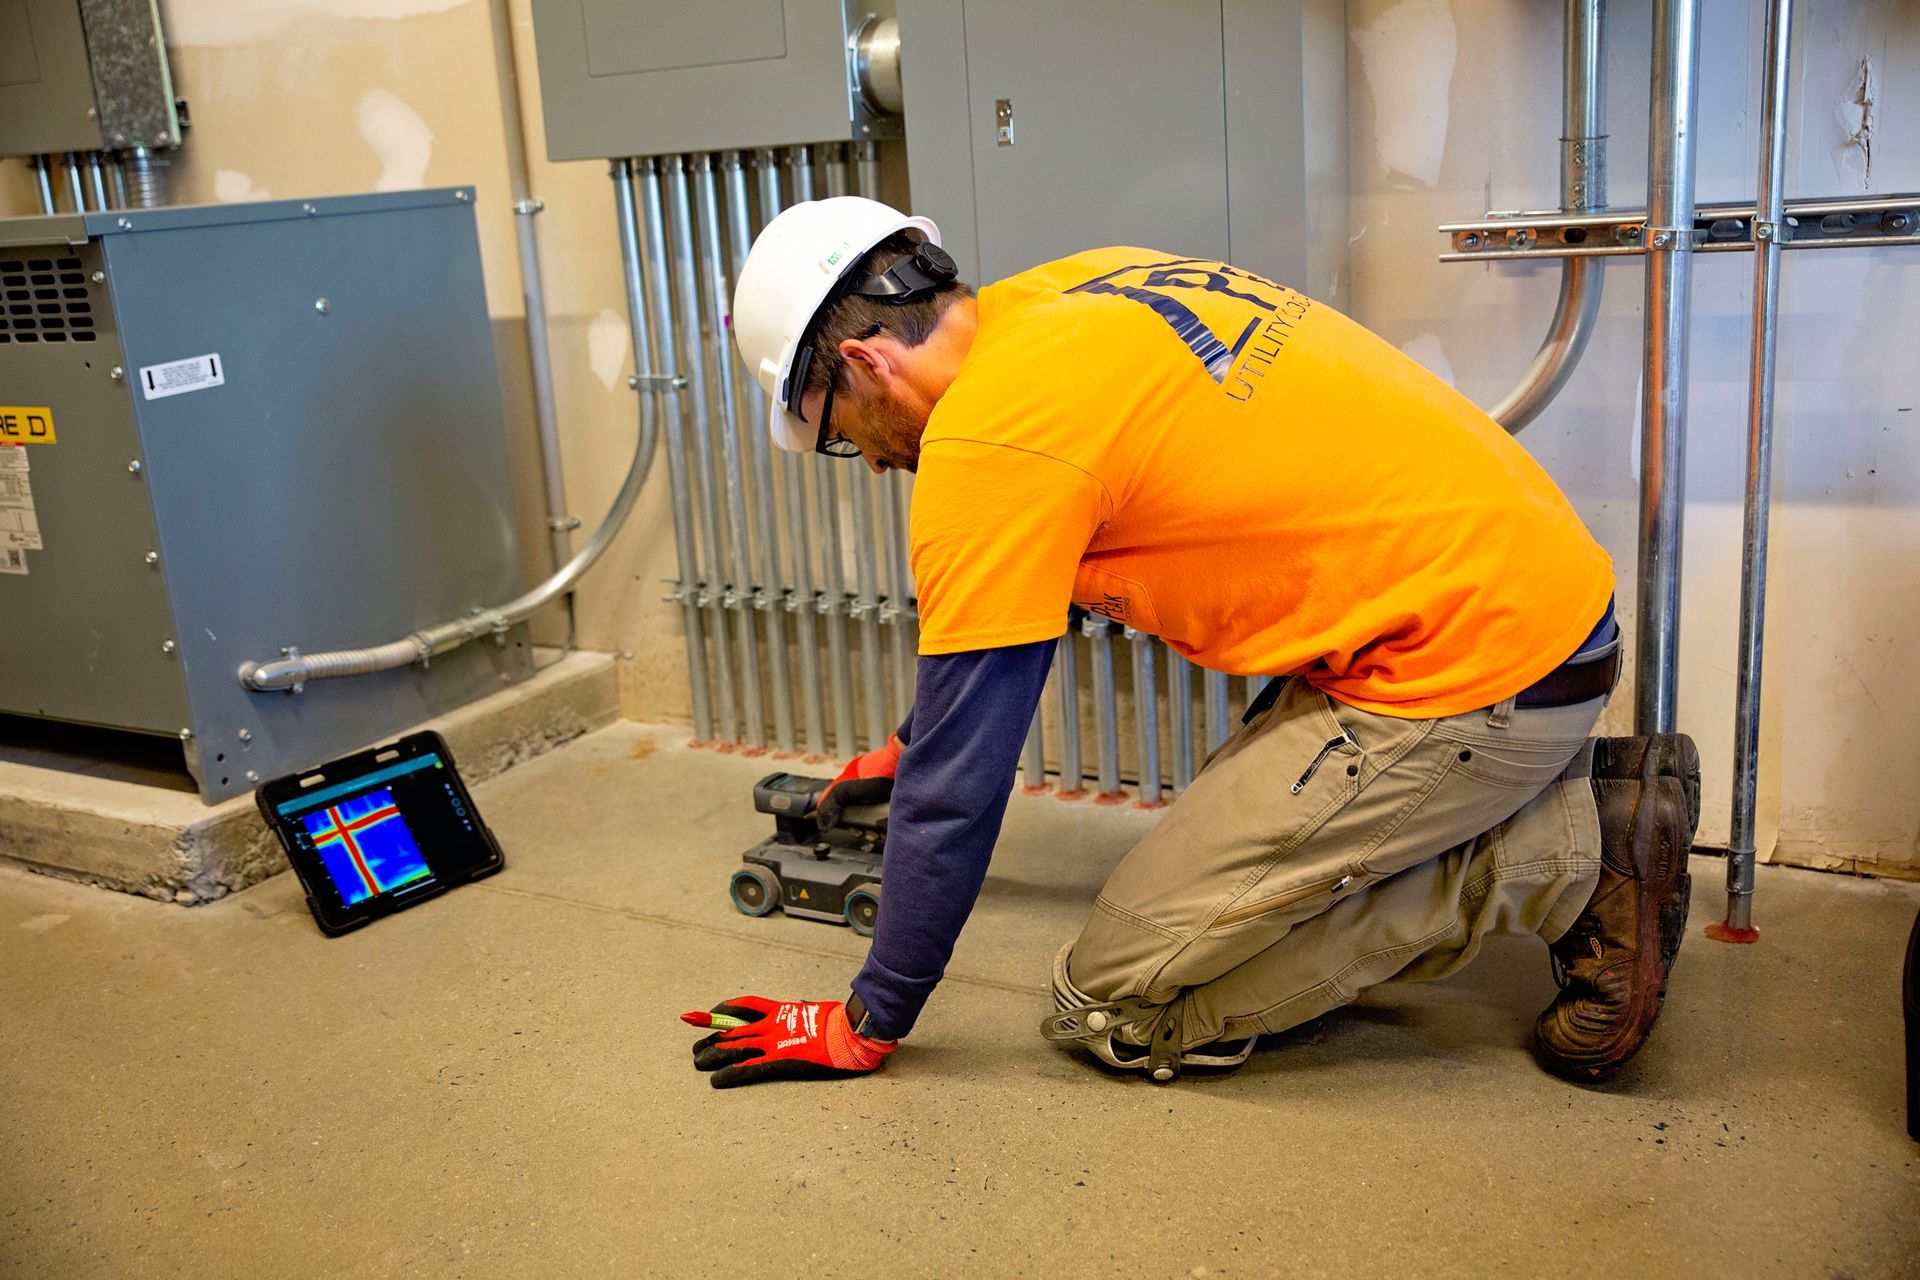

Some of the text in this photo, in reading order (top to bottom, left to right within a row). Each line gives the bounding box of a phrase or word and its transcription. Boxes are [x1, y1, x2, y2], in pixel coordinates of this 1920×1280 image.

[1226, 295, 1311, 402] UTILITY LOC
[26, 415, 46, 436] D
[1089, 592, 1126, 622] PEAK
